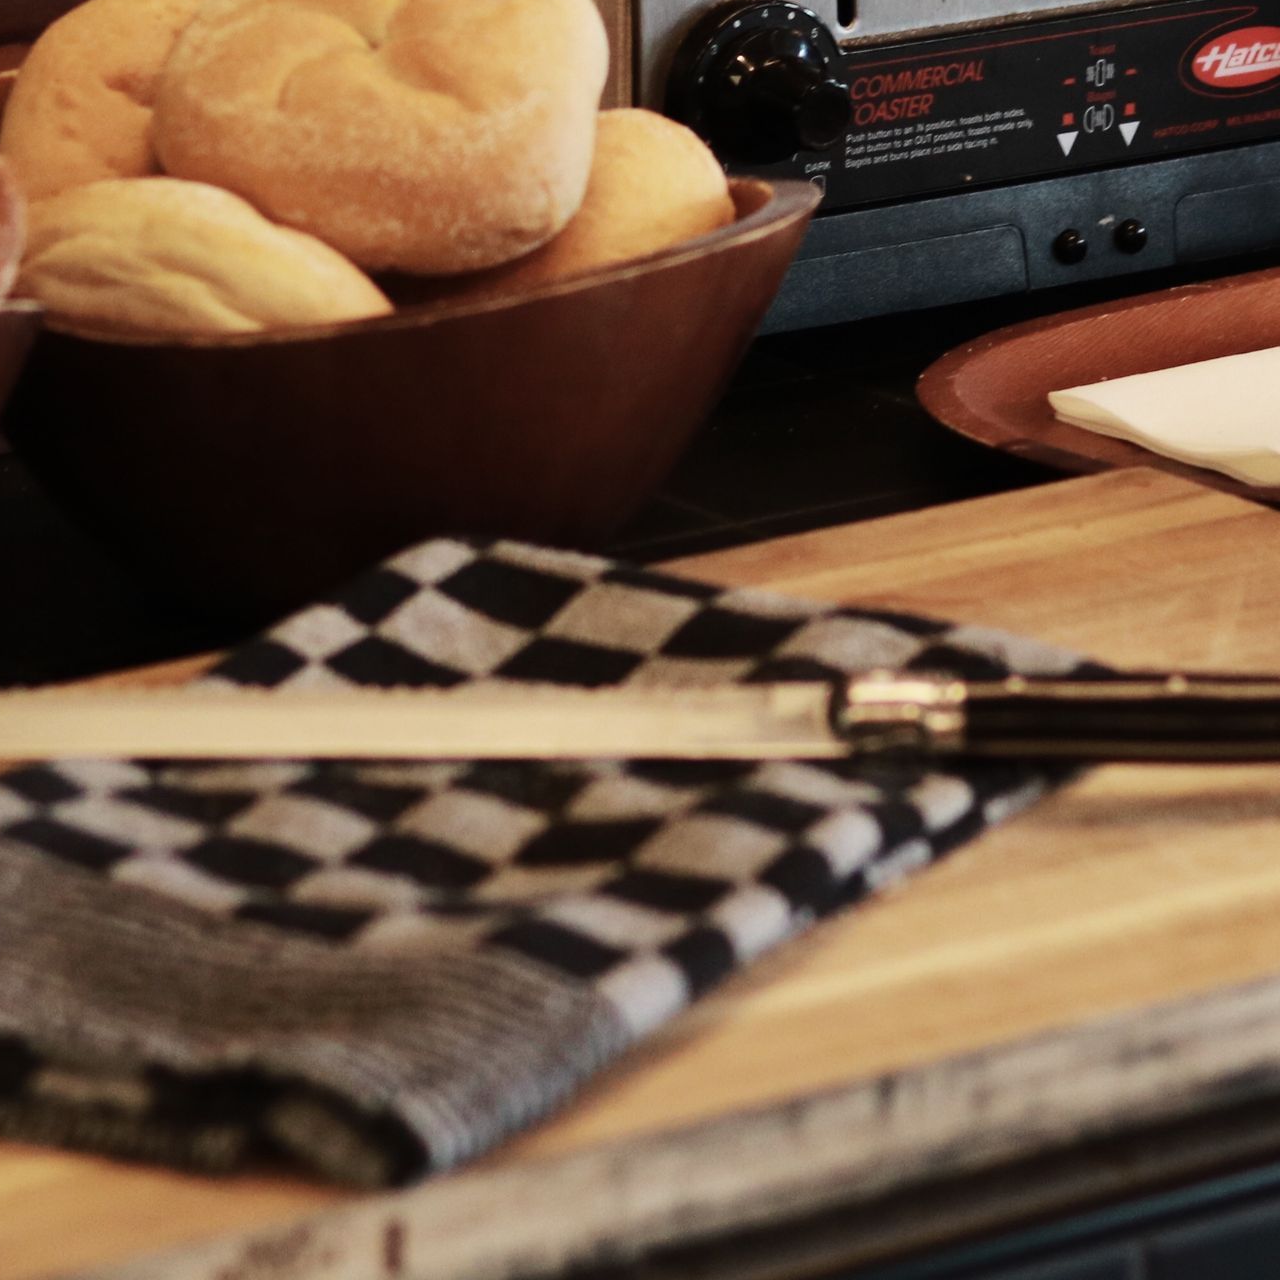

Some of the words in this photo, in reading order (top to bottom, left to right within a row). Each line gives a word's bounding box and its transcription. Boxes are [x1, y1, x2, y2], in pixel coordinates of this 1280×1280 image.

[850, 59, 986, 100] COMMERCIAL
[853, 93, 934, 127] OASTER
[846, 133, 866, 144] Push
[867, 129, 893, 141] button
[846, 145, 866, 156] Push
[866, 141, 892, 153] button
[873, 153, 888, 164] and
[804, 160, 832, 173] DARK
